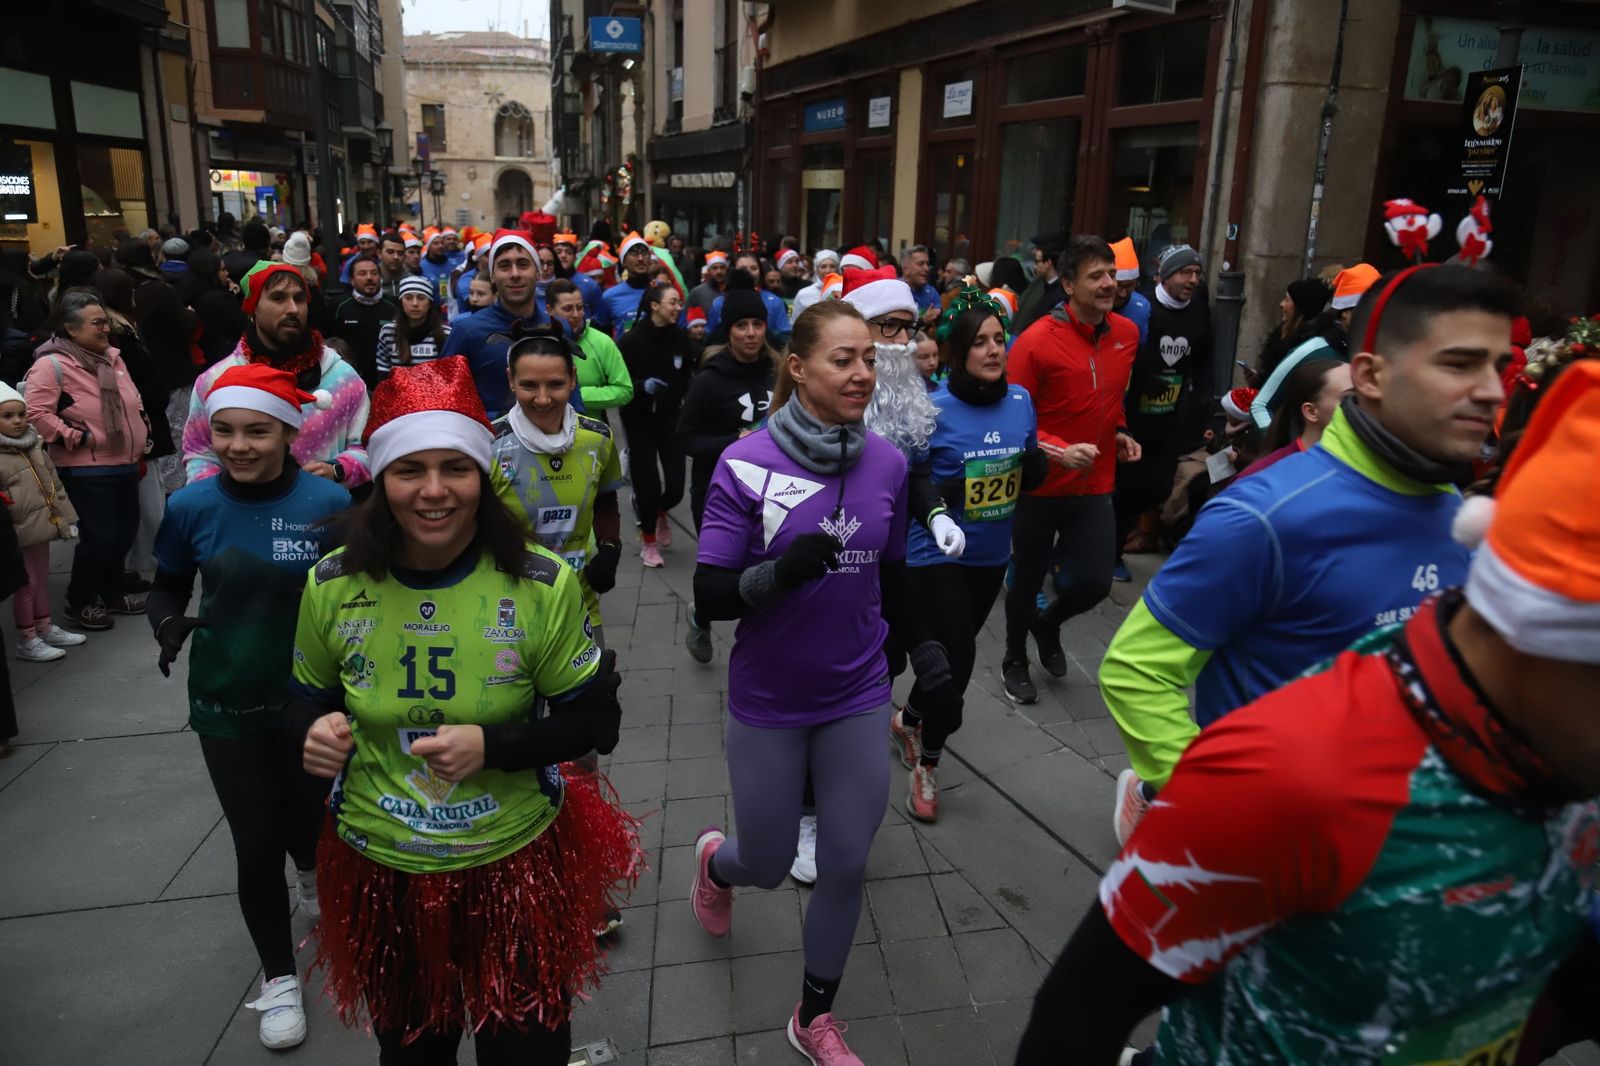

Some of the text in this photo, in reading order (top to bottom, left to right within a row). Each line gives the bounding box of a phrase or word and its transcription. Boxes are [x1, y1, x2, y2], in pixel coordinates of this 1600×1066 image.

[593, 40, 638, 50] Samsonite
[1537, 36, 1550, 54] la
[1553, 39, 1593, 57] salud
[412, 346, 431, 355] 688
[983, 431, 1001, 444] 46
[963, 450, 976, 459] SAN
[540, 474, 573, 482] MORALEJO
[773, 489, 807, 498] MERCURY
[970, 474, 1015, 504] 326
[543, 508, 572, 524] gaza
[982, 508, 999, 518] CAJA
[272, 552, 320, 561] OROTAVA
[1411, 563, 1439, 592] 46
[340, 600, 378, 610] MERCURY
[1375, 609, 1397, 626] SAN
[403, 623, 451, 633] MORALEJO
[484, 627, 527, 640] ZAMORA
[397, 645, 456, 700] 15
[380, 796, 497, 821] CAJA RURAL
[407, 821, 470, 830] DE ZAMORA
